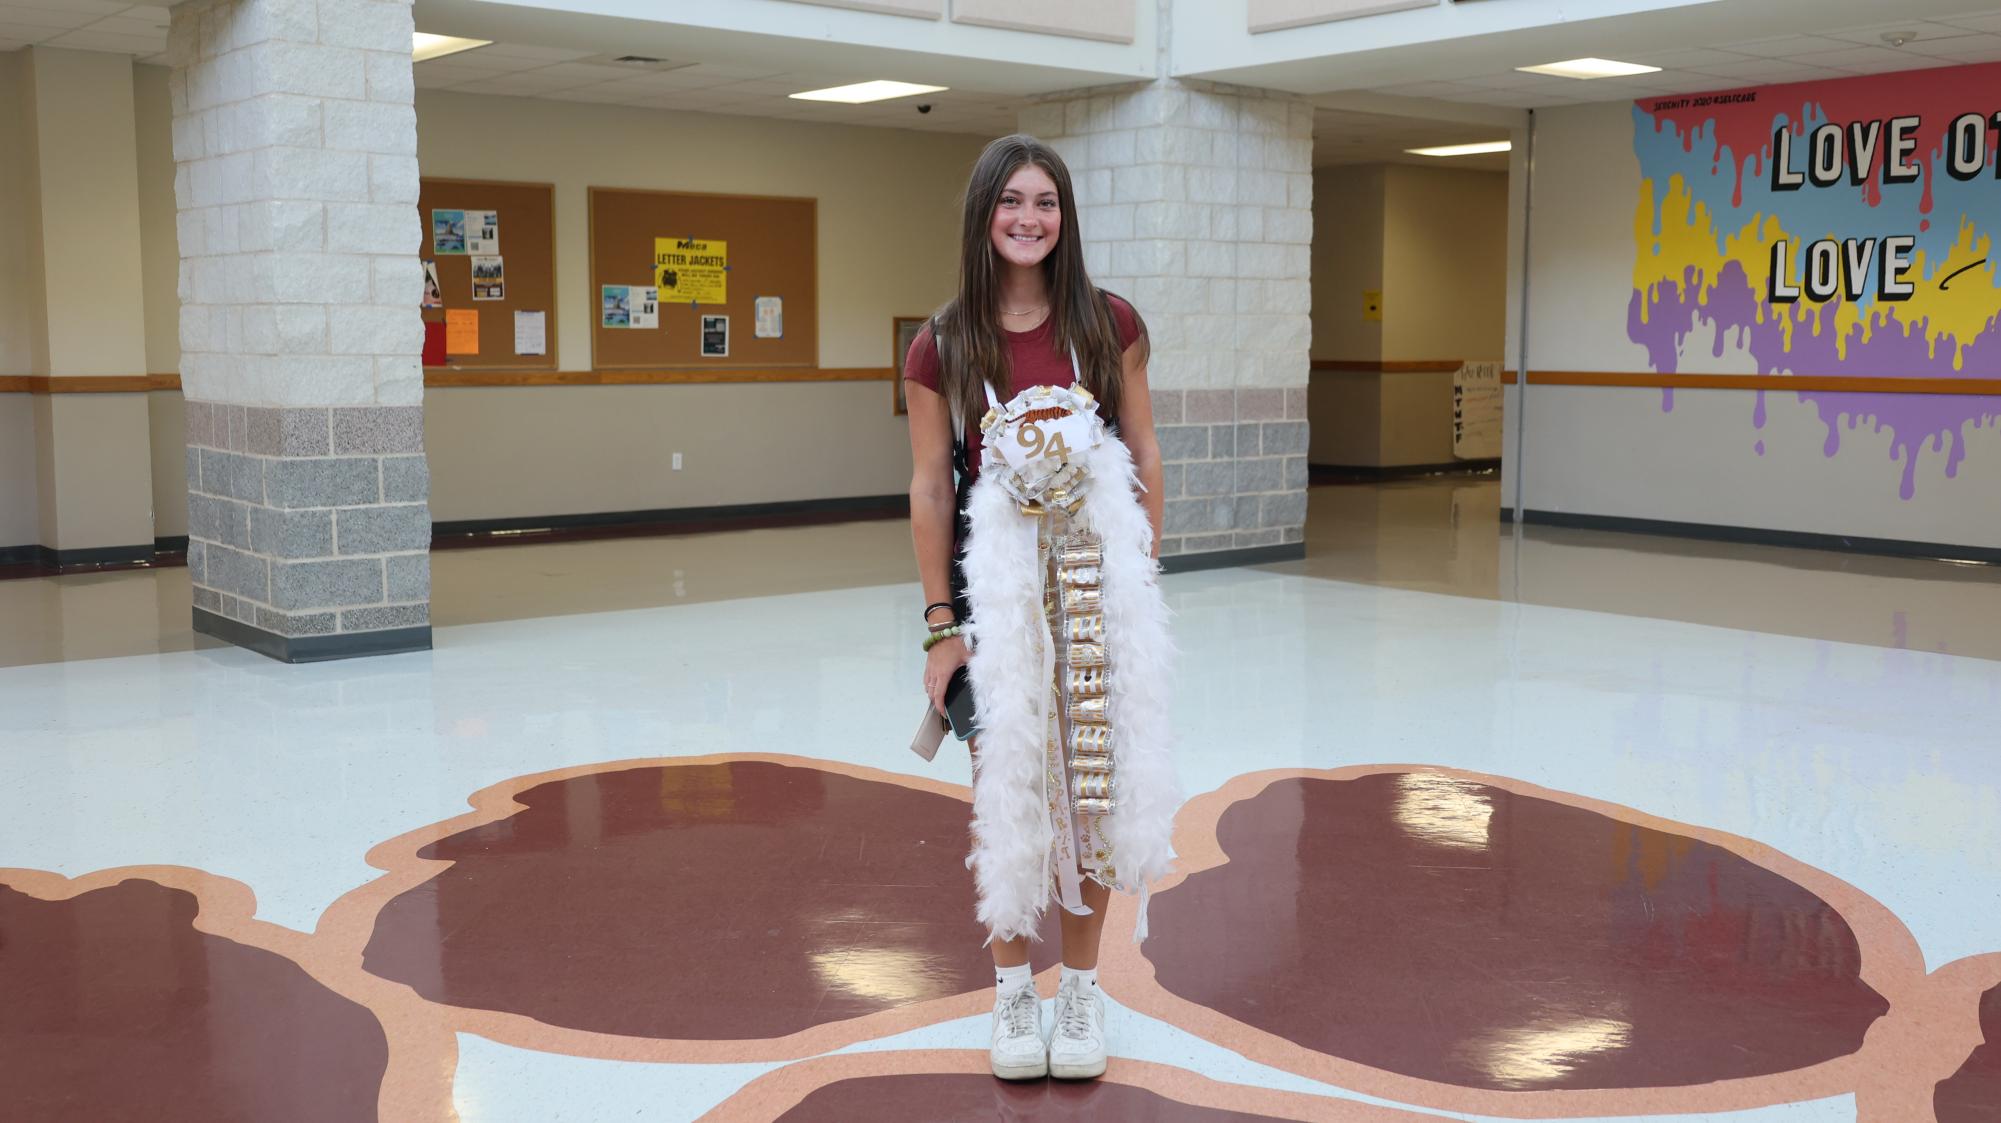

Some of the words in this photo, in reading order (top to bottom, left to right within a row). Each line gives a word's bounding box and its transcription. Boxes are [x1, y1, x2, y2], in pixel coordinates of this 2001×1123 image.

[1771, 115, 1921, 192] LOVE
[657, 253, 687, 266] LETTER
[689, 255, 725, 268] JACKETS
[1768, 235, 1916, 303] LOVE
[1016, 425, 1072, 465] 94
